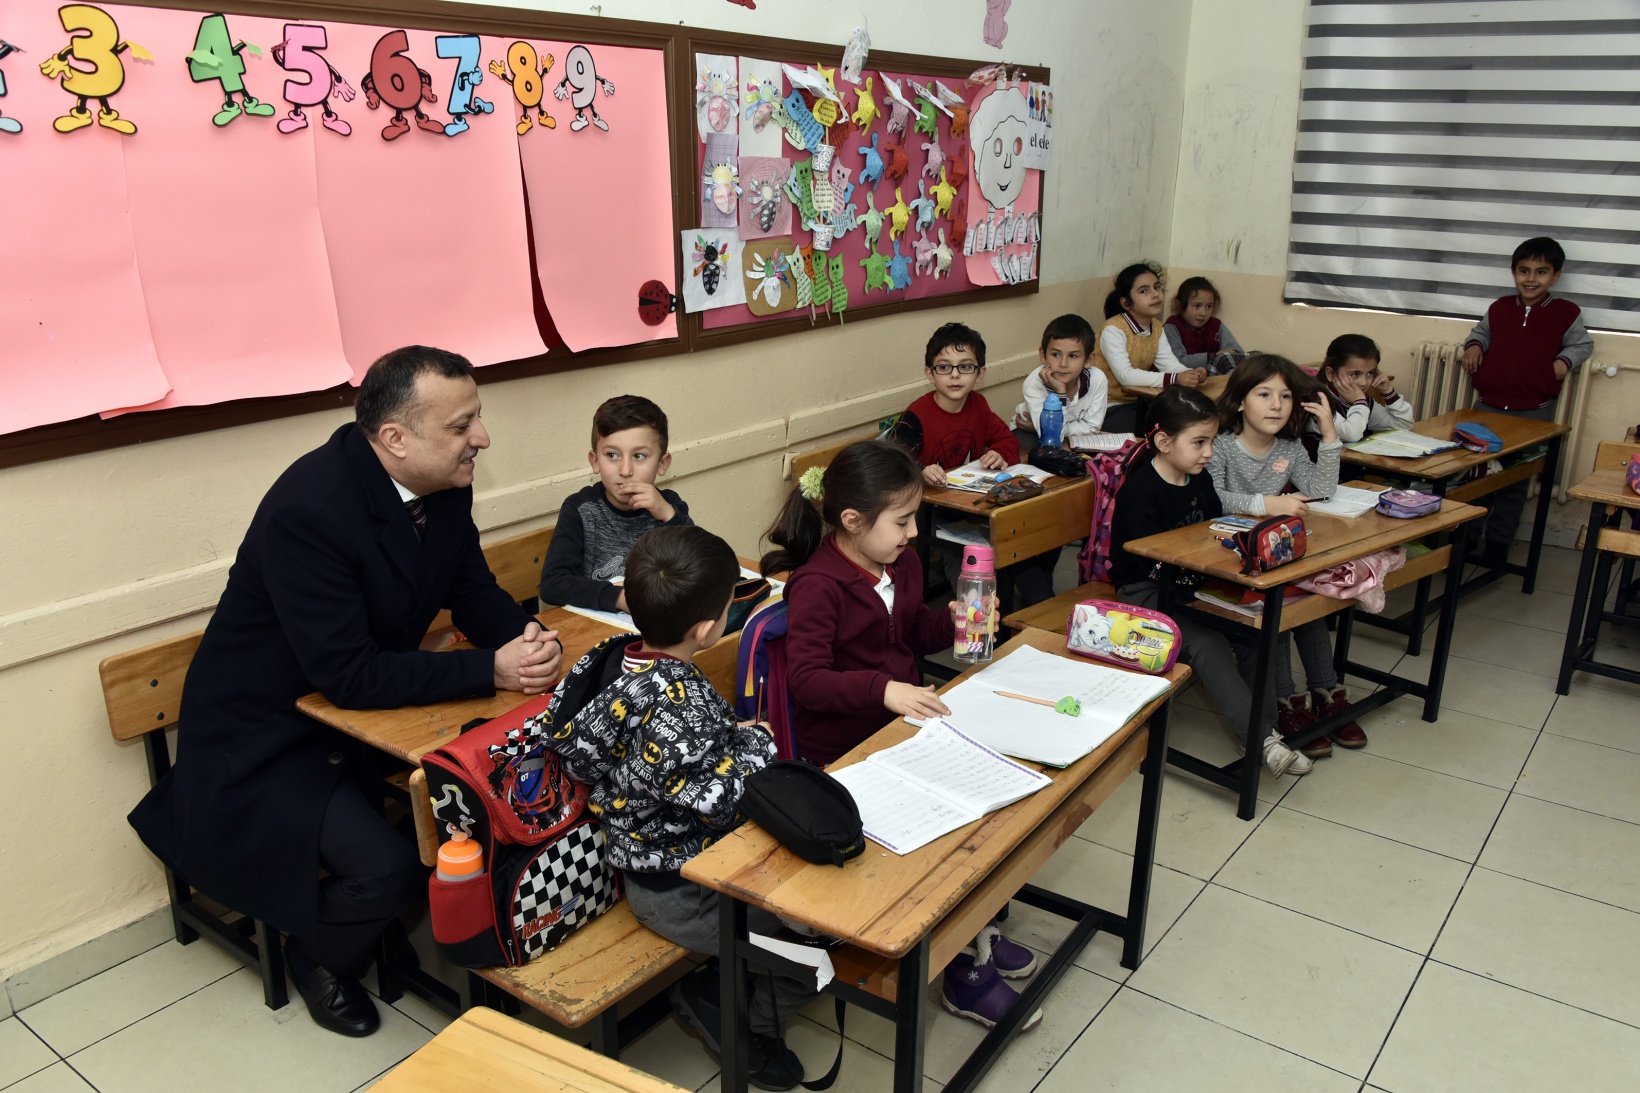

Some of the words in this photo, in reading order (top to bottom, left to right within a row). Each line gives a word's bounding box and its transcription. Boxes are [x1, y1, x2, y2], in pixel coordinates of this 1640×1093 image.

[191, 14, 245, 93] 4
[371, 30, 422, 110] 6
[507, 41, 545, 108] 8
[565, 45, 597, 108] 9
[1030, 133, 1037, 147] el
[1039, 135, 1050, 149] ele
[655, 707, 679, 726] FORCE
[655, 722, 678, 742] GOOD
[520, 772, 529, 782] 07
[522, 906, 562, 939] RACING
